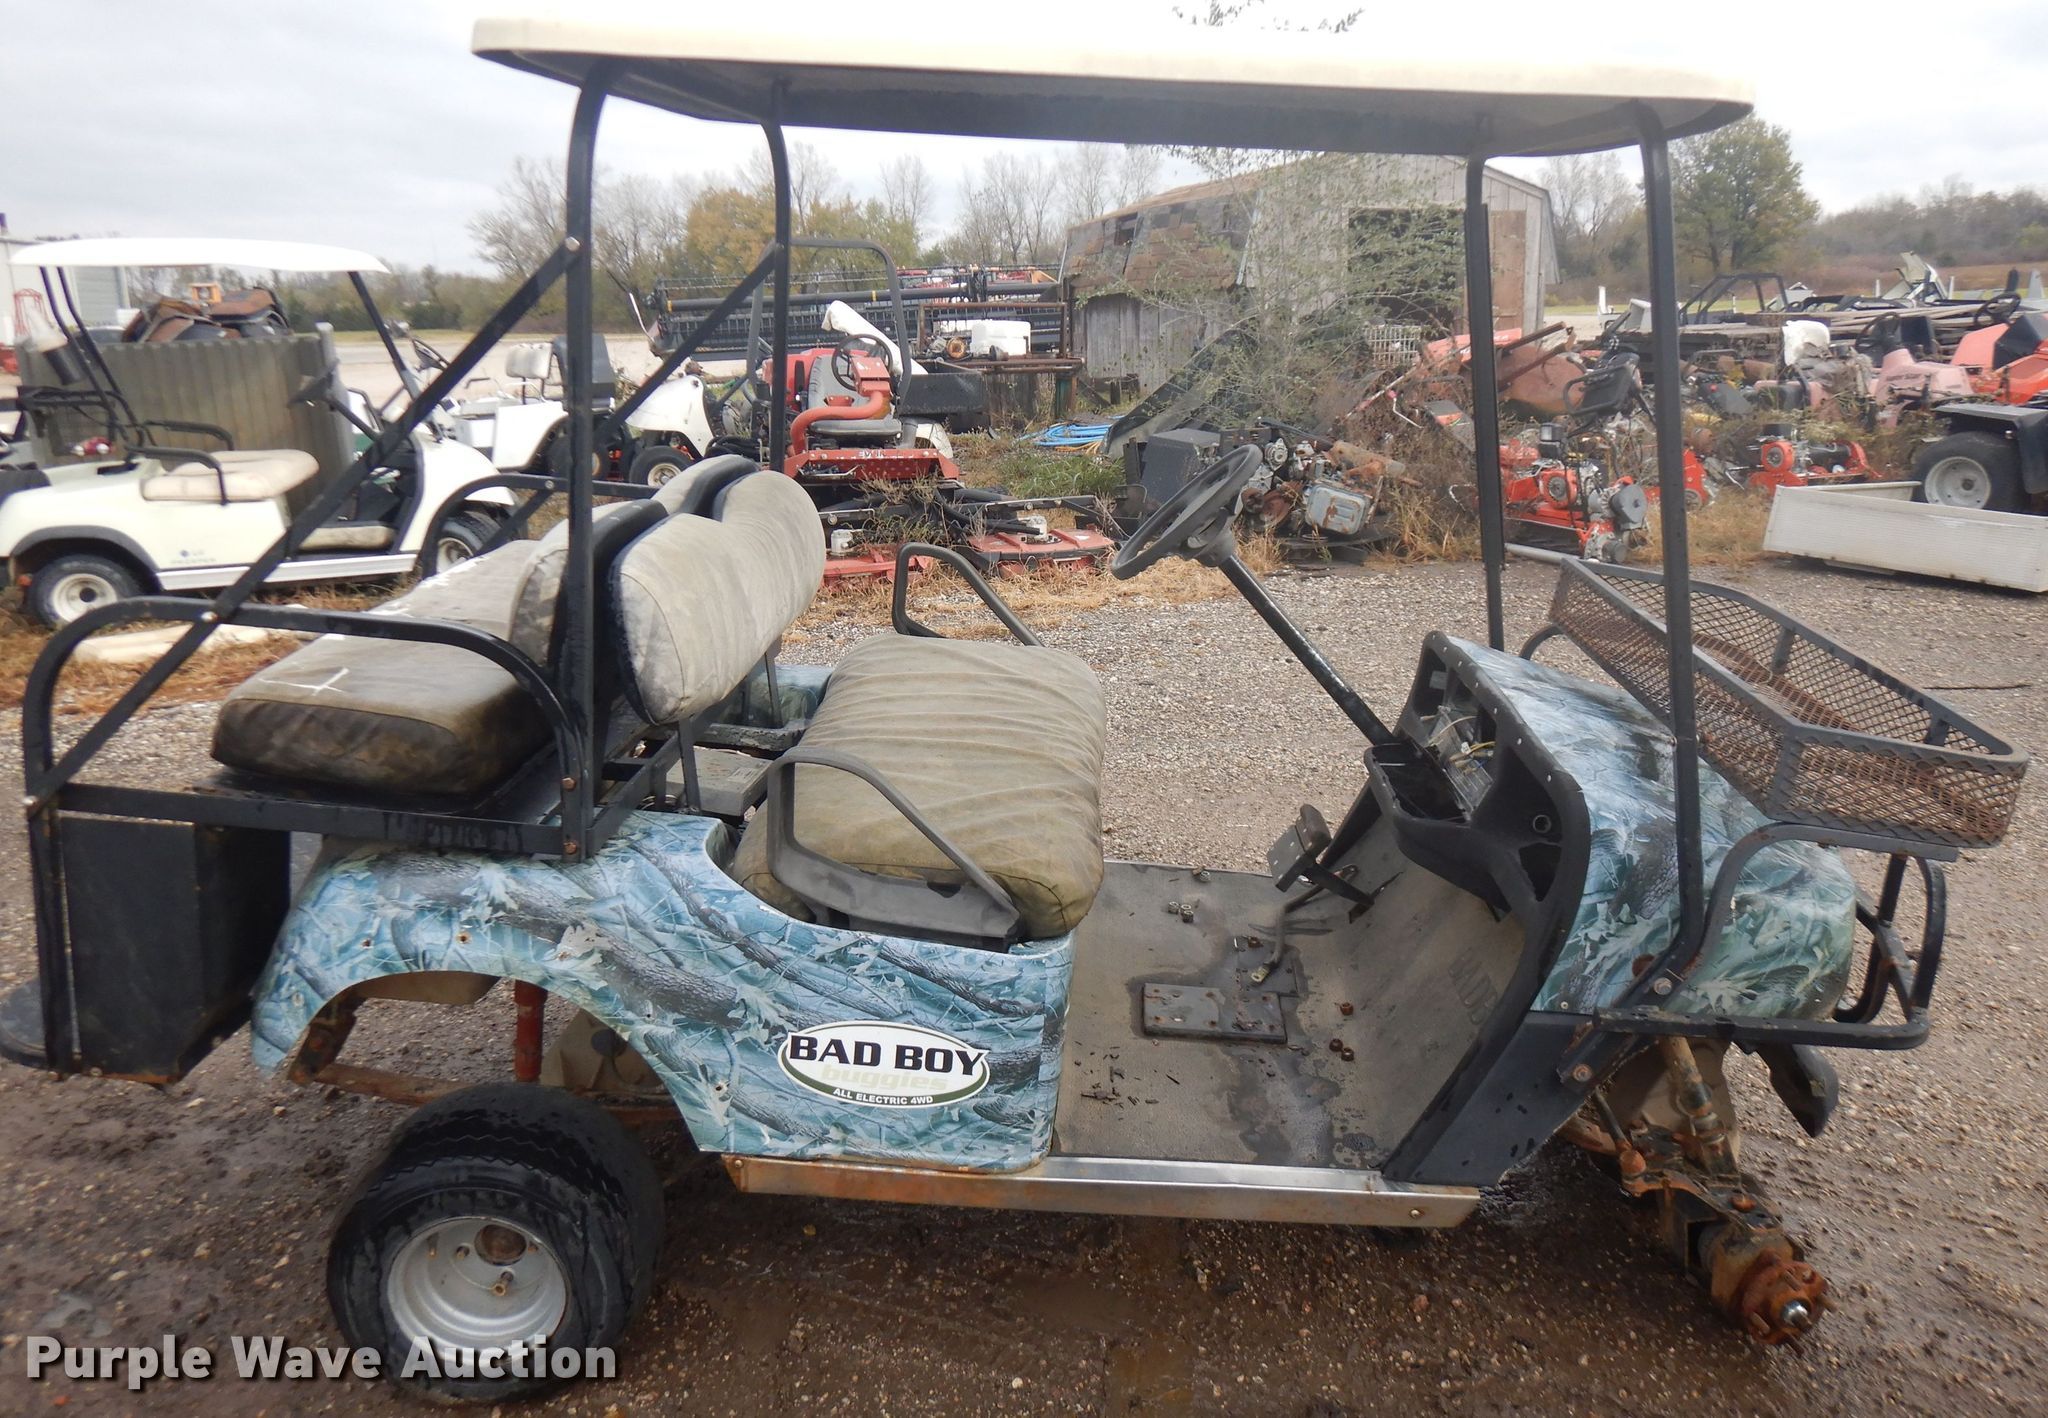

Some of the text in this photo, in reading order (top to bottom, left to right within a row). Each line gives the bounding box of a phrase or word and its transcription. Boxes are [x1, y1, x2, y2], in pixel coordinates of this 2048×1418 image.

[789, 1035, 984, 1076] BAD BOY
[821, 1064, 947, 1091] buggies
[833, 1088, 933, 1105] ALL ELECTRIC 4WD
